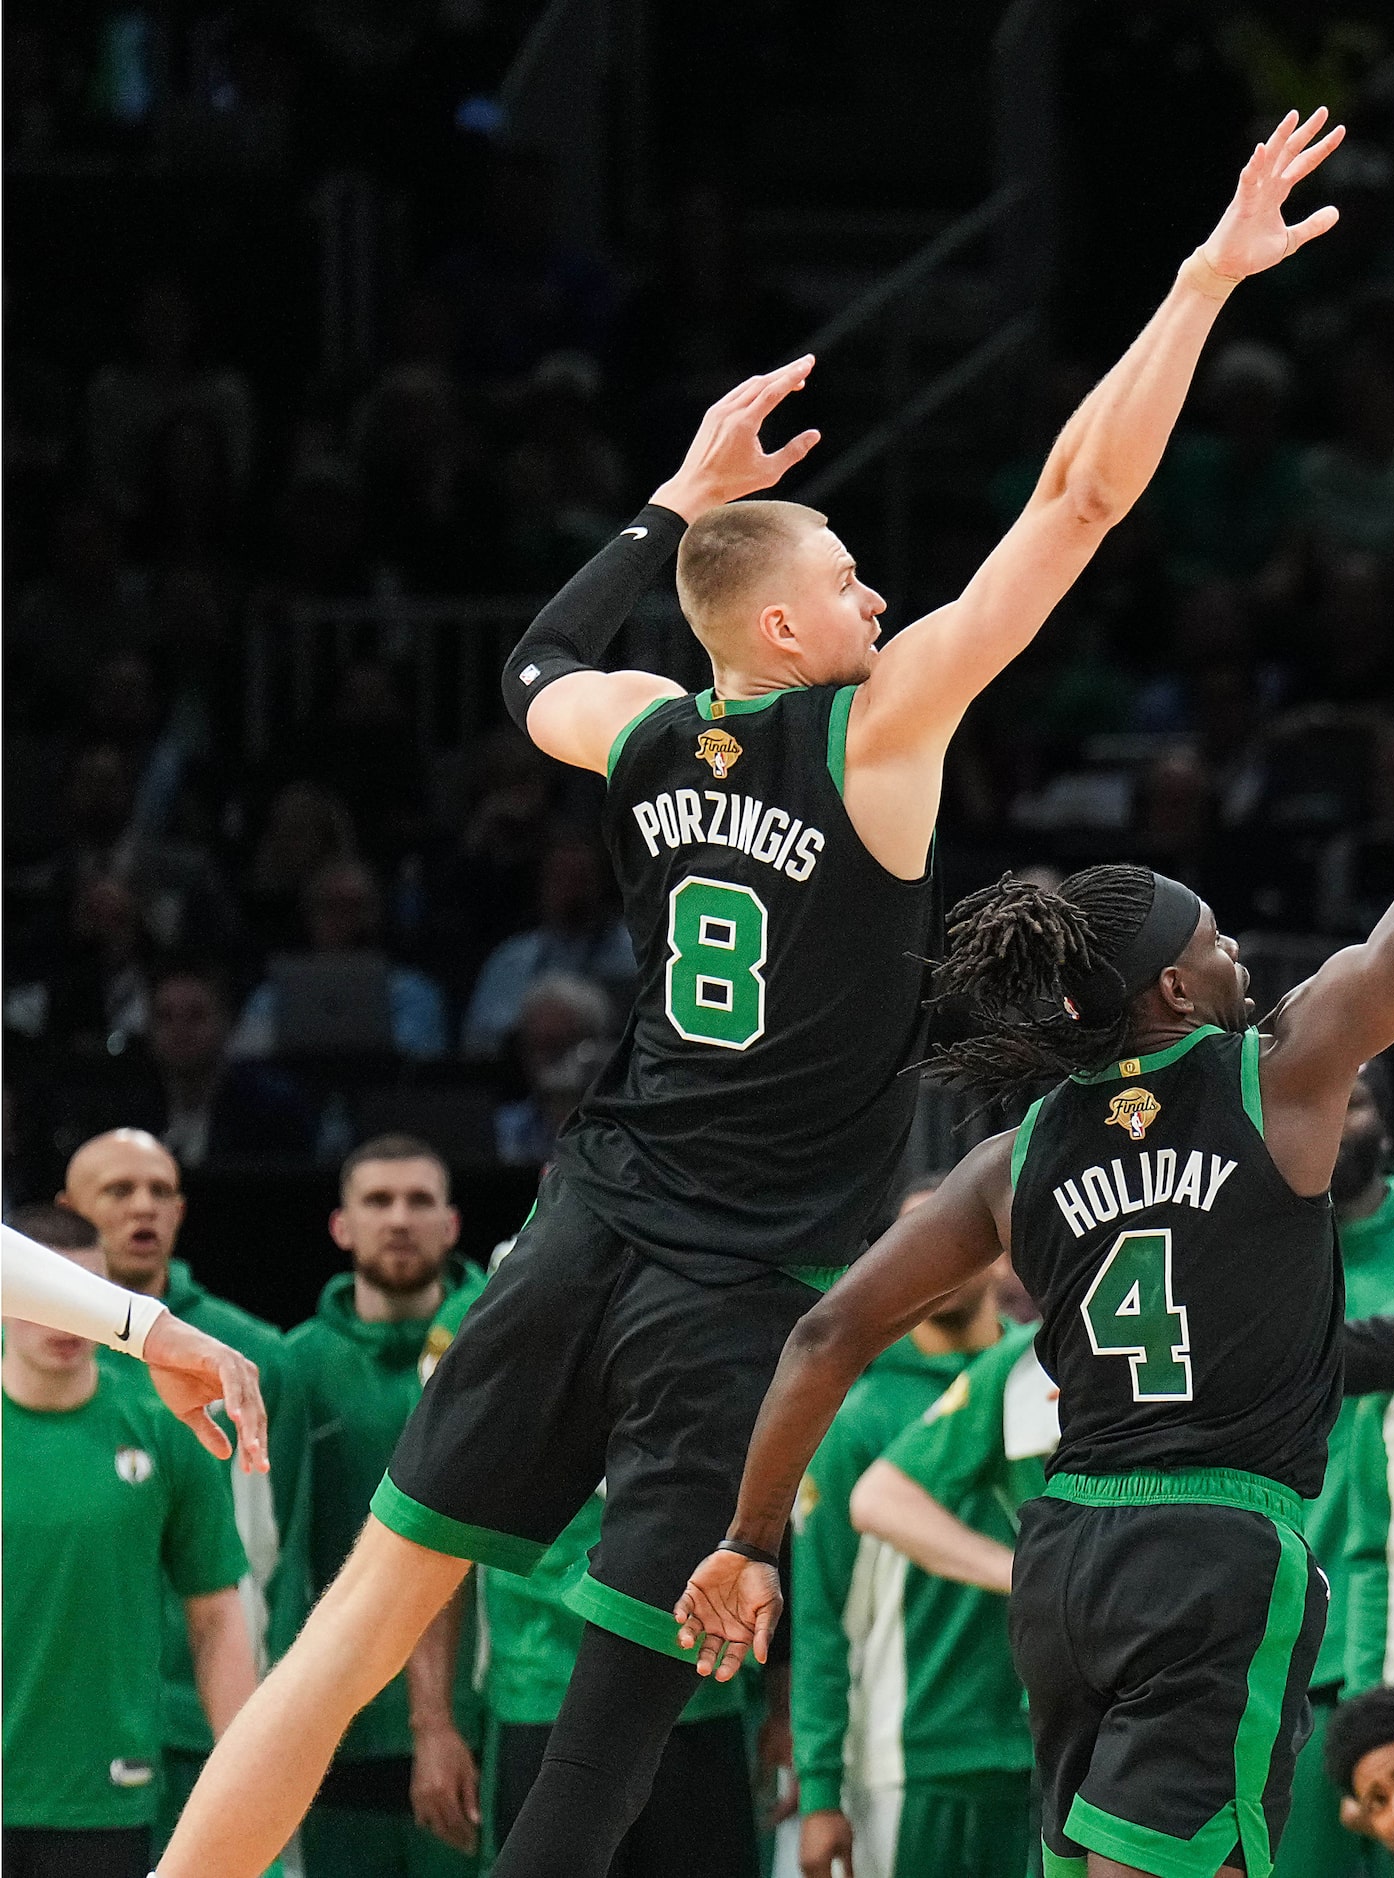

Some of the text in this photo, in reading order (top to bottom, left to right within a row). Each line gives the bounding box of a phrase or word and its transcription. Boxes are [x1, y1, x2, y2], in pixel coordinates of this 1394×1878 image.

[698, 736, 740, 756] Finals
[632, 788, 826, 882] PORZINGIS
[665, 875, 768, 1051] 8
[1106, 1095, 1157, 1123] Finals
[1052, 1148, 1239, 1238] HOLIDAY
[1080, 1228, 1193, 1402] 4
